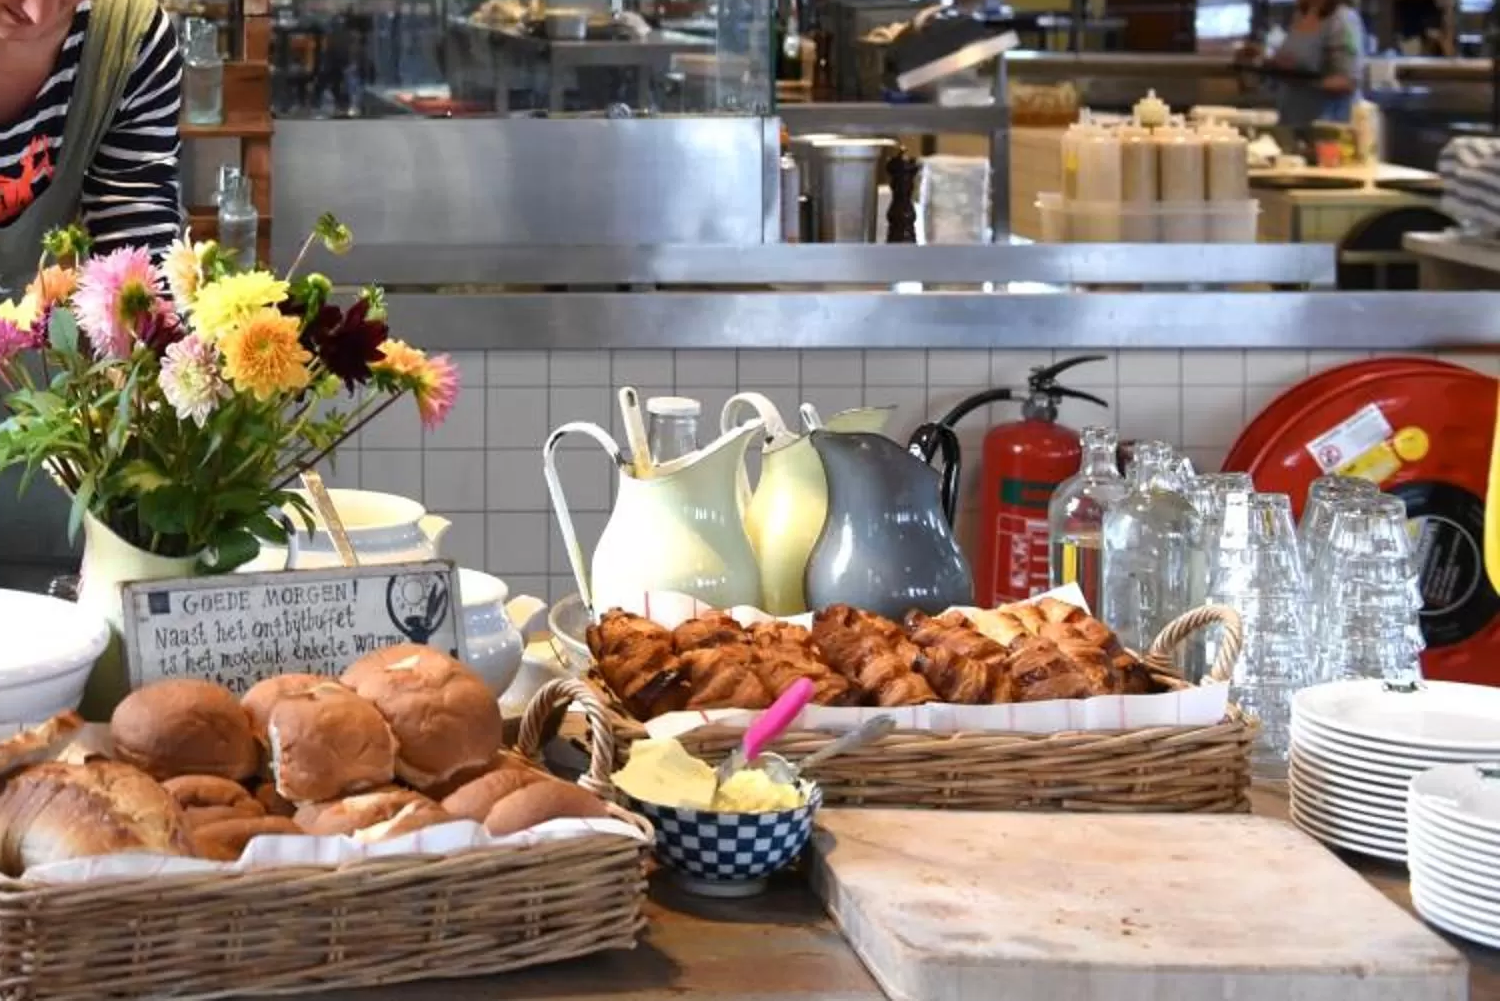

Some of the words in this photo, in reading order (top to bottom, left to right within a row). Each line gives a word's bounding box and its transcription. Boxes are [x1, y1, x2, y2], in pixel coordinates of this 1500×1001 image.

[183, 590, 250, 615] GOEDE
[155, 620, 208, 650] Naast
[214, 618, 248, 644] het
[181, 646, 216, 675] het
